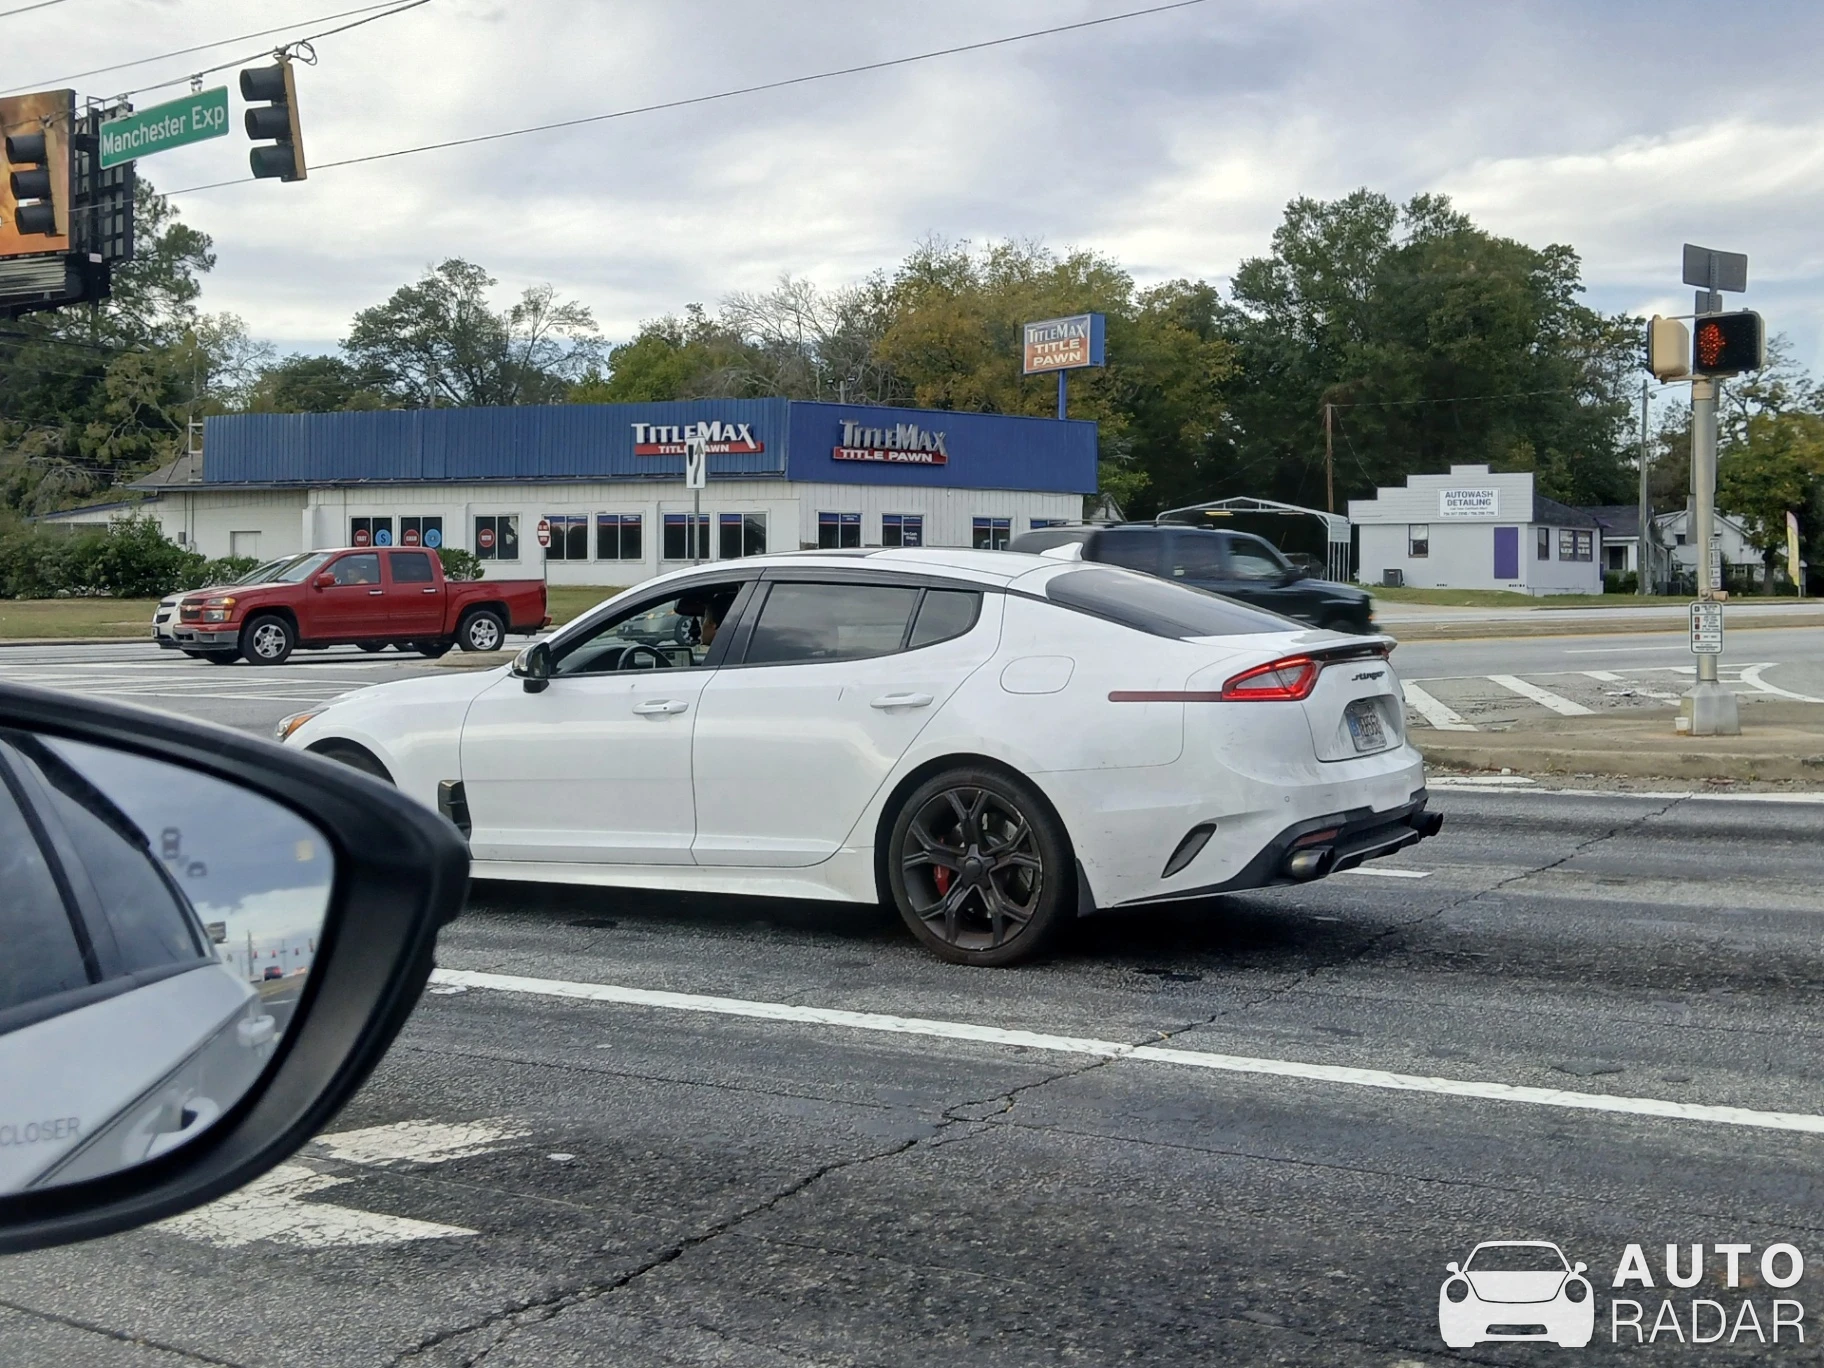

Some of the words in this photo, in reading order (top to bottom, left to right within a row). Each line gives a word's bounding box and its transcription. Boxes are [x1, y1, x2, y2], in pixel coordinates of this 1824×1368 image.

[103, 115, 186, 156] Manchester
[192, 105, 224, 130] Exp
[1034, 338, 1080, 354] TITLE
[1033, 351, 1081, 367] PAWN
[658, 445, 686, 454] TITL
[704, 444, 729, 453] AWN
[840, 449, 884, 459] TITLE
[889, 452, 932, 462] PAWN
[1445, 490, 1493, 499] AUTOWASH
[1447, 499, 1491, 507] DETAILING
[0, 1116, 81, 1146] CLOSER
